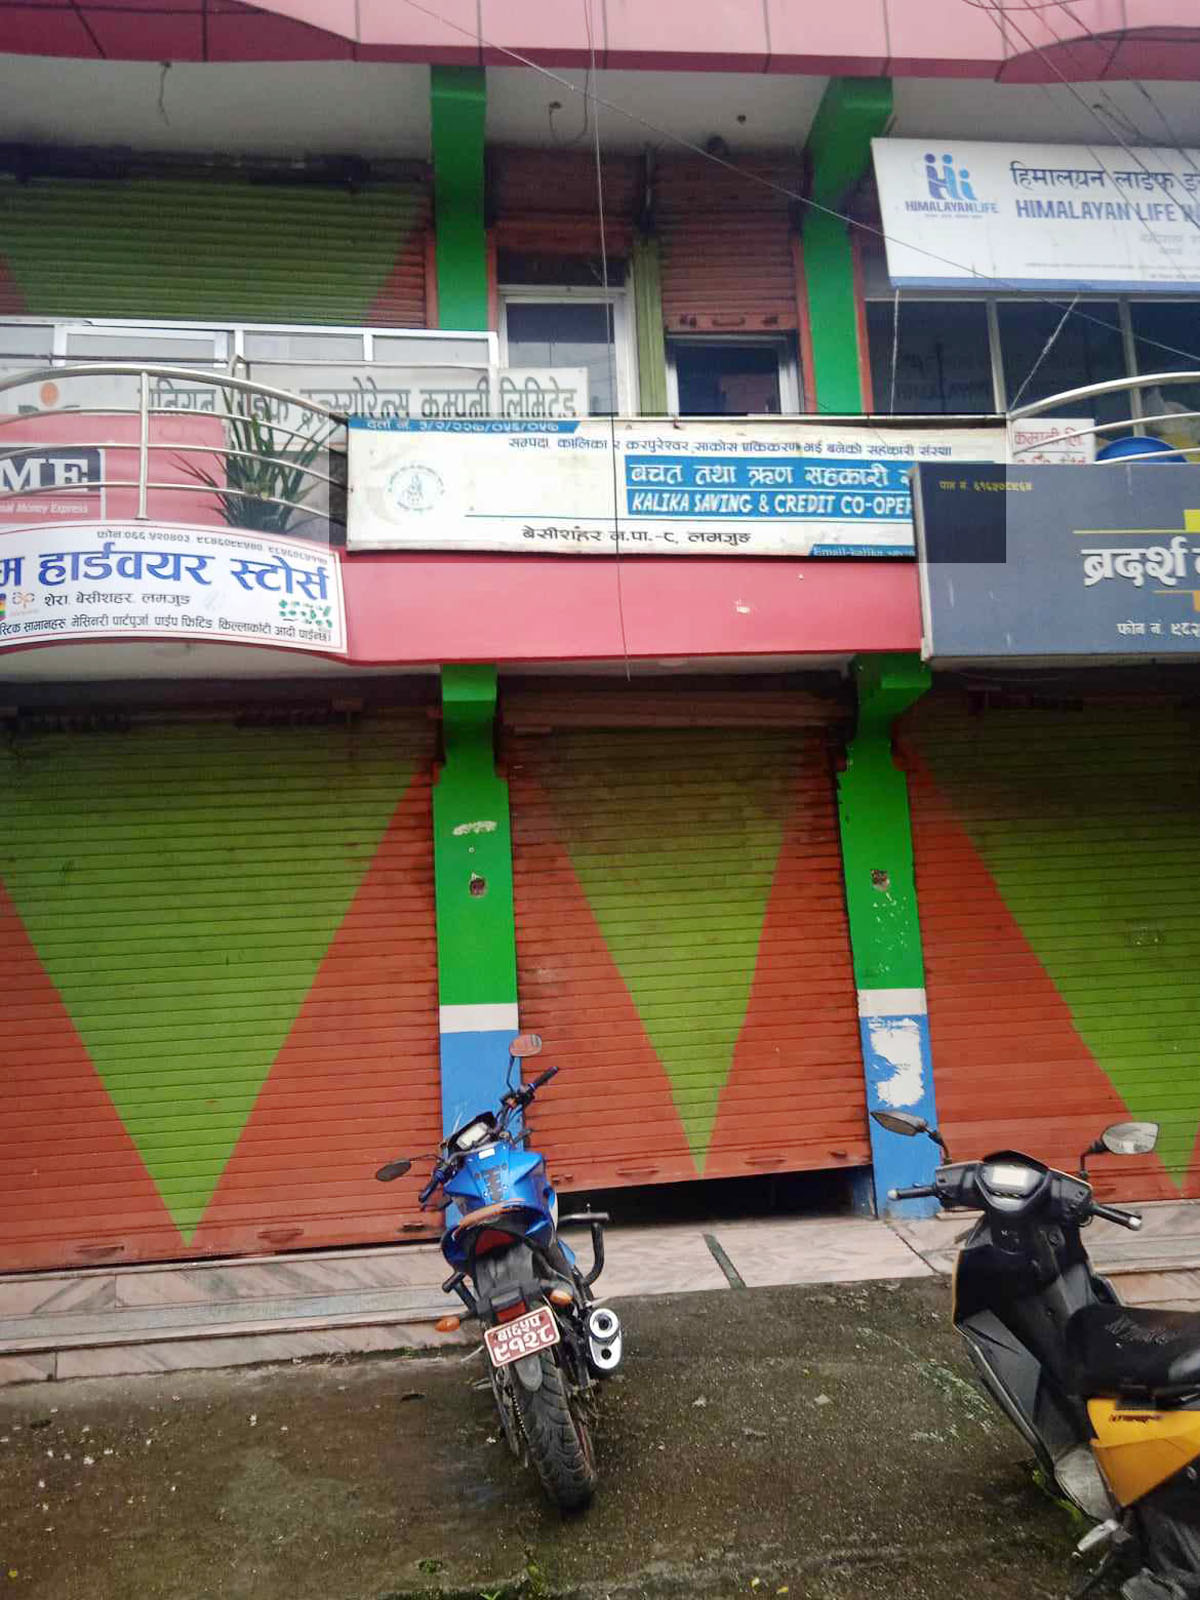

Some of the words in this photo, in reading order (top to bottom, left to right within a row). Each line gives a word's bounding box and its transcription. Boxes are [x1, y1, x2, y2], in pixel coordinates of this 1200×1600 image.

[1010, 161, 1105, 190] हिमालयन
[1114, 172, 1174, 191] लाइफ
[1017, 200, 1131, 220] HIMALAYAN
[1137, 202, 1177, 221] LIFE
[557, 436, 608, 449] कालिका
[867, 443, 914, 456] सहकारी
[631, 464, 682, 483] बचत
[695, 464, 736, 484] तथा
[747, 466, 794, 485] ऋण
[805, 463, 888, 487] सहकारी
[632, 494, 688, 511] KALIKA
[694, 496, 752, 513] SAVING
[759, 496, 769, 514] &
[775, 496, 835, 514] CREDIT
[689, 531, 752, 546] लमजुङ
[39, 541, 216, 588] हार्डवयर
[230, 555, 329, 600] स्टोर्स
[1117, 619, 1144, 635] फोन
